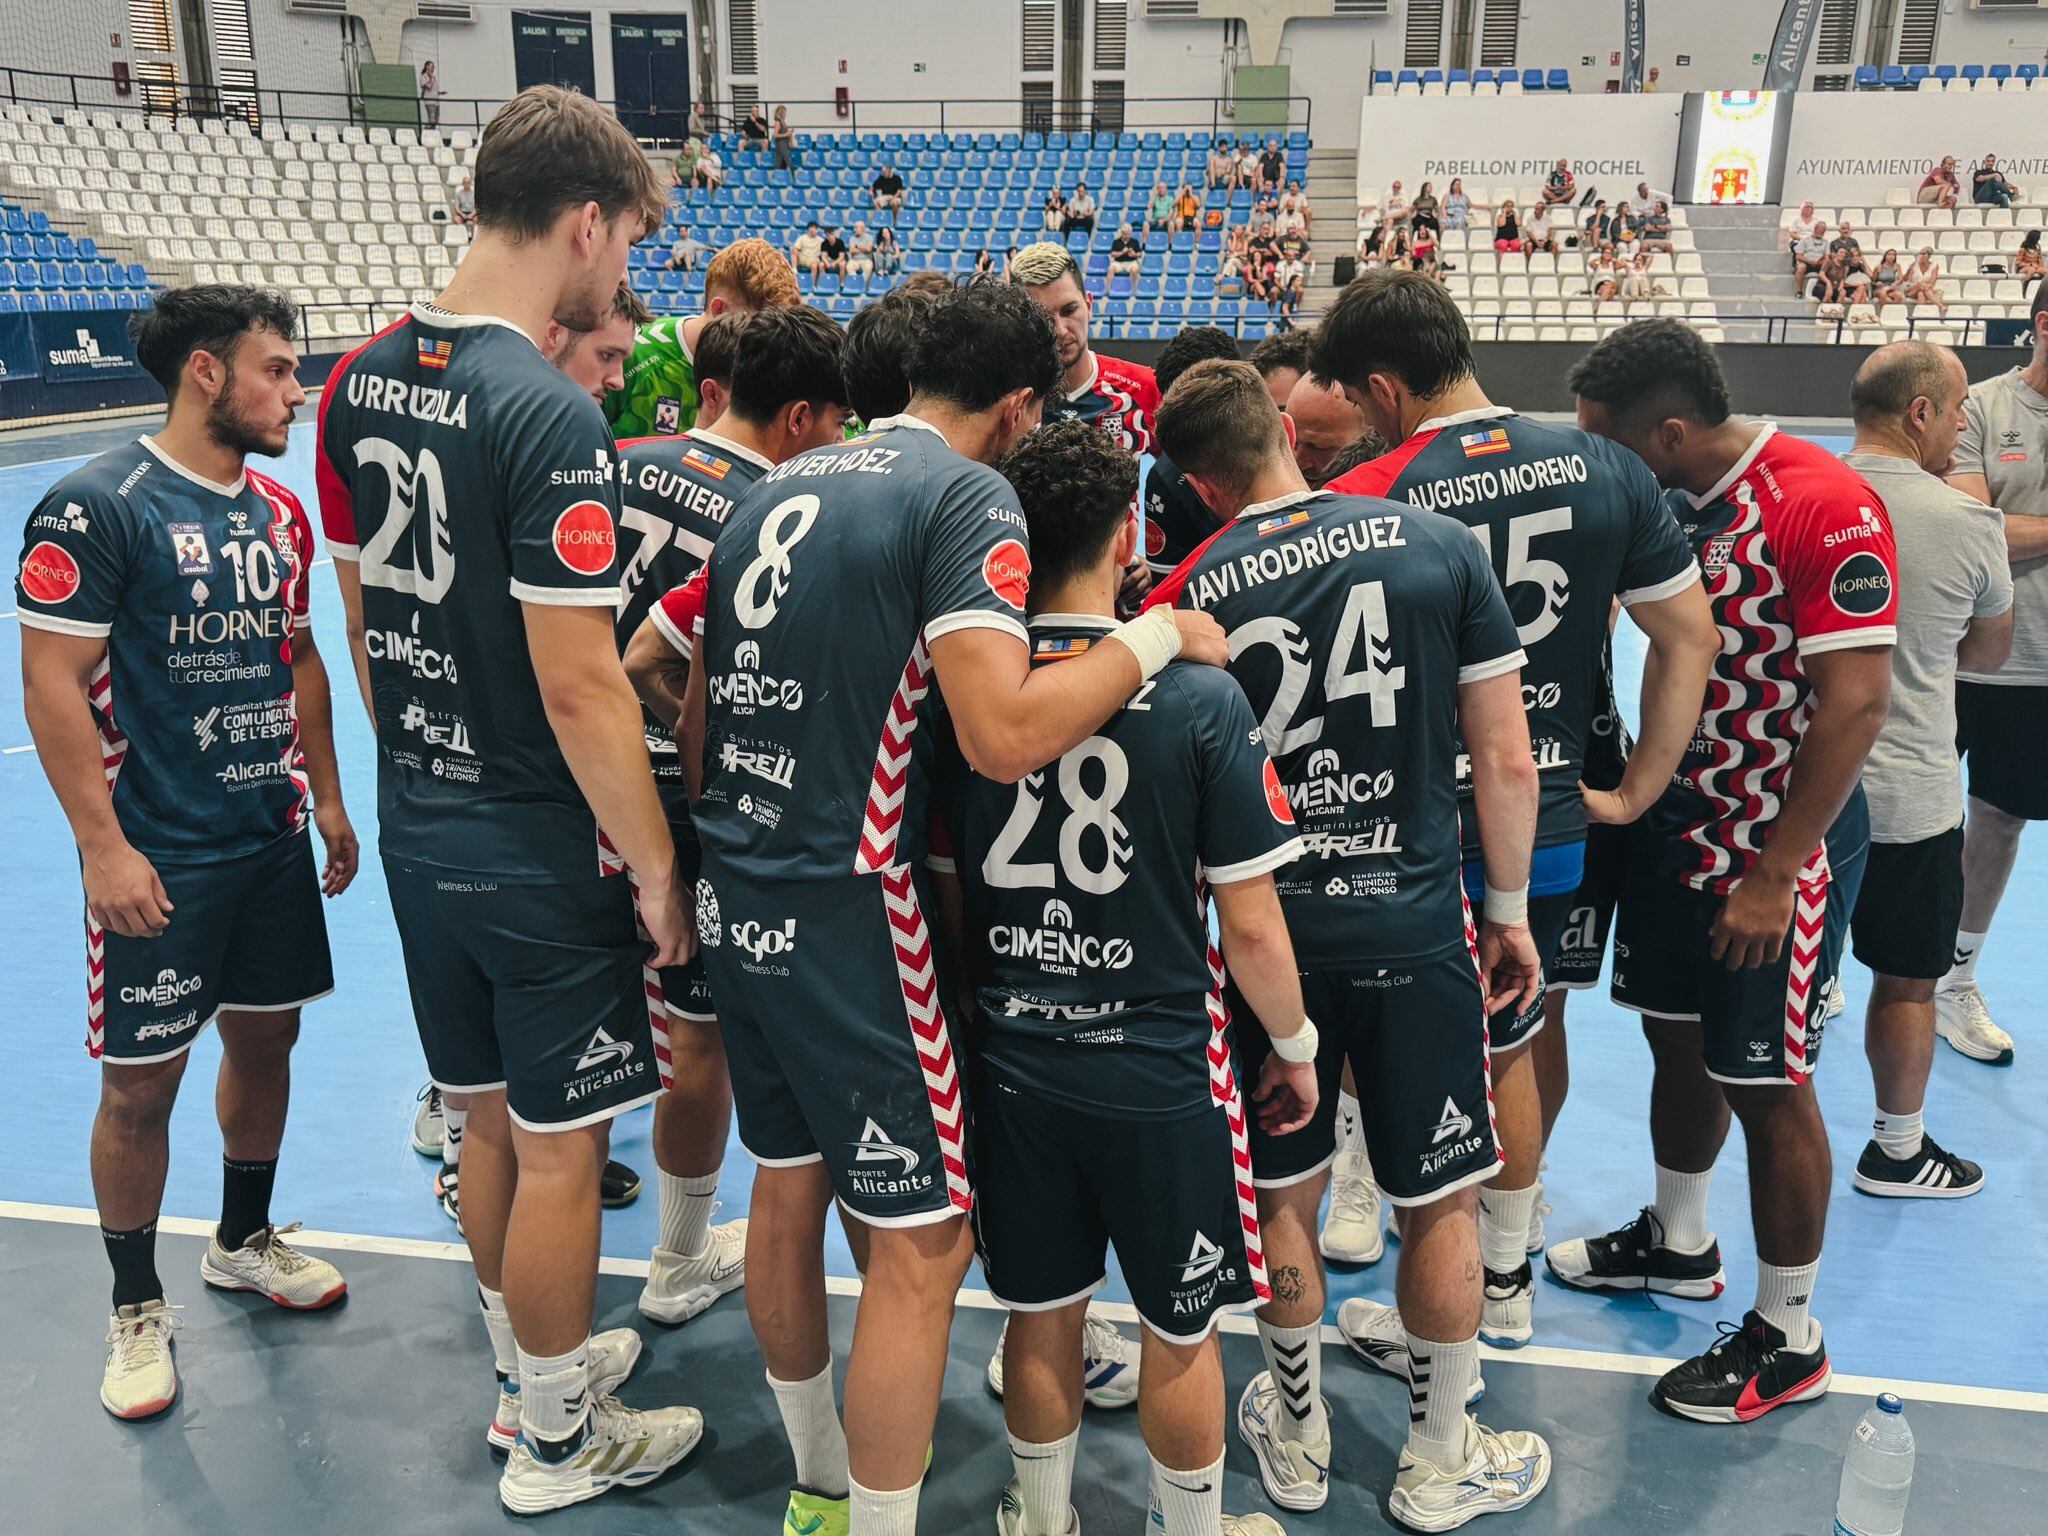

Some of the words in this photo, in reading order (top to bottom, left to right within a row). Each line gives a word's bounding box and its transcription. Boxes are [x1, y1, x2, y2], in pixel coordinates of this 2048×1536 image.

[522, 26, 547, 36] SALIDA
[620, 28, 645, 38] SALIDA
[1424, 160, 1516, 176] PABELLON
[1573, 160, 1645, 176] ROCHEL
[1796, 158, 1933, 175] AYUNTAMIENTO
[49, 348, 90, 365] suma
[550, 469, 604, 485] suma
[1407, 471, 1499, 512] AUGUSTO
[1499, 454, 1588, 497] MORENO
[352, 436, 455, 604] 20
[229, 528, 256, 536] hummel
[1823, 523, 1872, 548] suma
[1240, 515, 1407, 588] RODRÍGUEZ
[733, 493, 821, 629] 8
[24, 561, 77, 584] HORNEO
[219, 540, 279, 603] 10
[1833, 575, 1890, 595] HORNEO
[1227, 580, 1406, 757] 24
[224, 701, 263, 714] Comunitat
[230, 729, 247, 744] DE
[446, 763, 481, 775] TRINIDAD
[446, 772, 480, 783] ALFONSO
[226, 784, 251, 794] Sports
[981, 735, 1134, 896] 28
[1305, 805, 1345, 817] ALICANTE
[1303, 815, 1391, 832] Suministros
[1352, 872, 1396, 880] FUNDACION
[1352, 878, 1397, 888] TRINIDAD
[1353, 886, 1397, 896] ALFONSO
[731, 918, 796, 963] sGo!
[771, 965, 790, 977] Club
[1040, 962, 1078, 977] ALICANTE
[1351, 979, 1392, 988] Wellness
[1393, 975, 1413, 986] Club
[1074, 1027, 1123, 1039] FUNDACION
[563, 1069, 606, 1088] DEPORTES
[566, 1062, 645, 1102] Alicante
[1421, 1136, 1483, 1174] Alicante
[847, 1169, 887, 1178] DEPORTES
[853, 1174, 932, 1194] Alicante
[1170, 1281, 1211, 1299] DEPORTES
